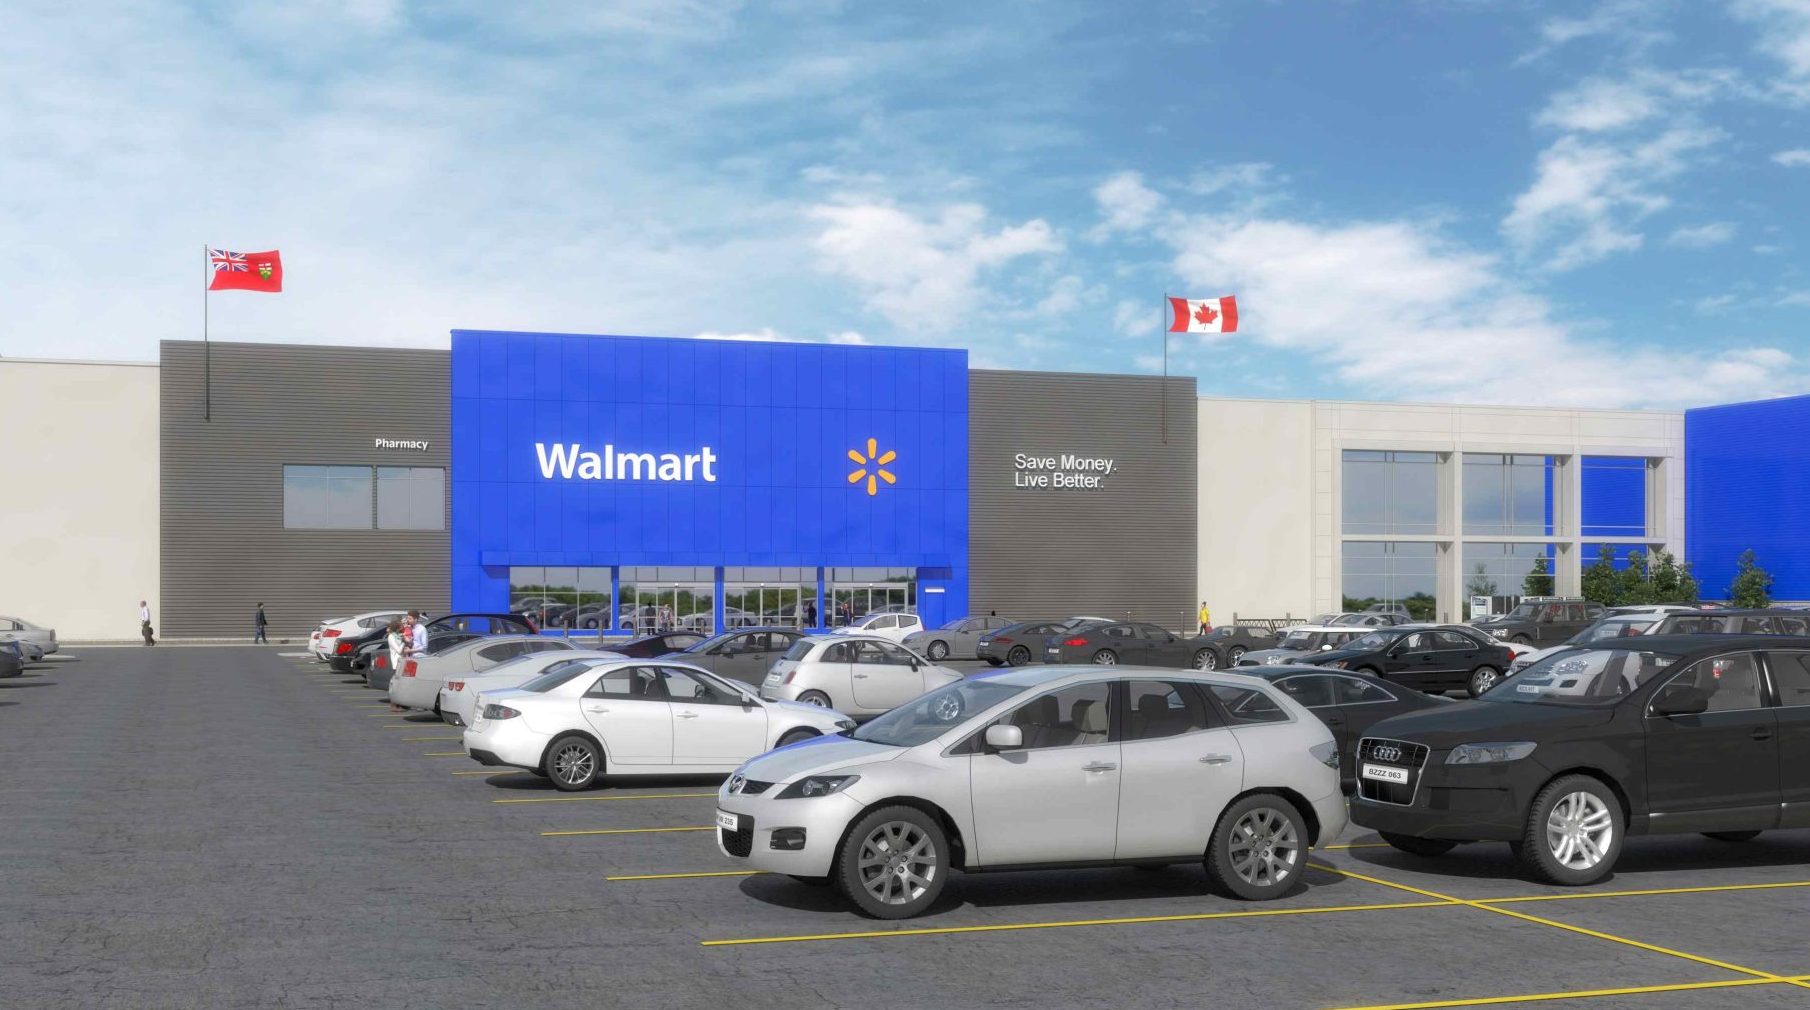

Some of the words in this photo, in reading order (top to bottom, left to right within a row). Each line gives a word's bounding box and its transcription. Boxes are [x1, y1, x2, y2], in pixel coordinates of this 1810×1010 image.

[375, 438, 429, 451] Pharmacy
[535, 443, 717, 482] Walmart
[1015, 453, 1056, 469] Save
[1060, 454, 1117, 475] Money.
[1015, 471, 1048, 487] Live
[1053, 472, 1104, 488] Better.
